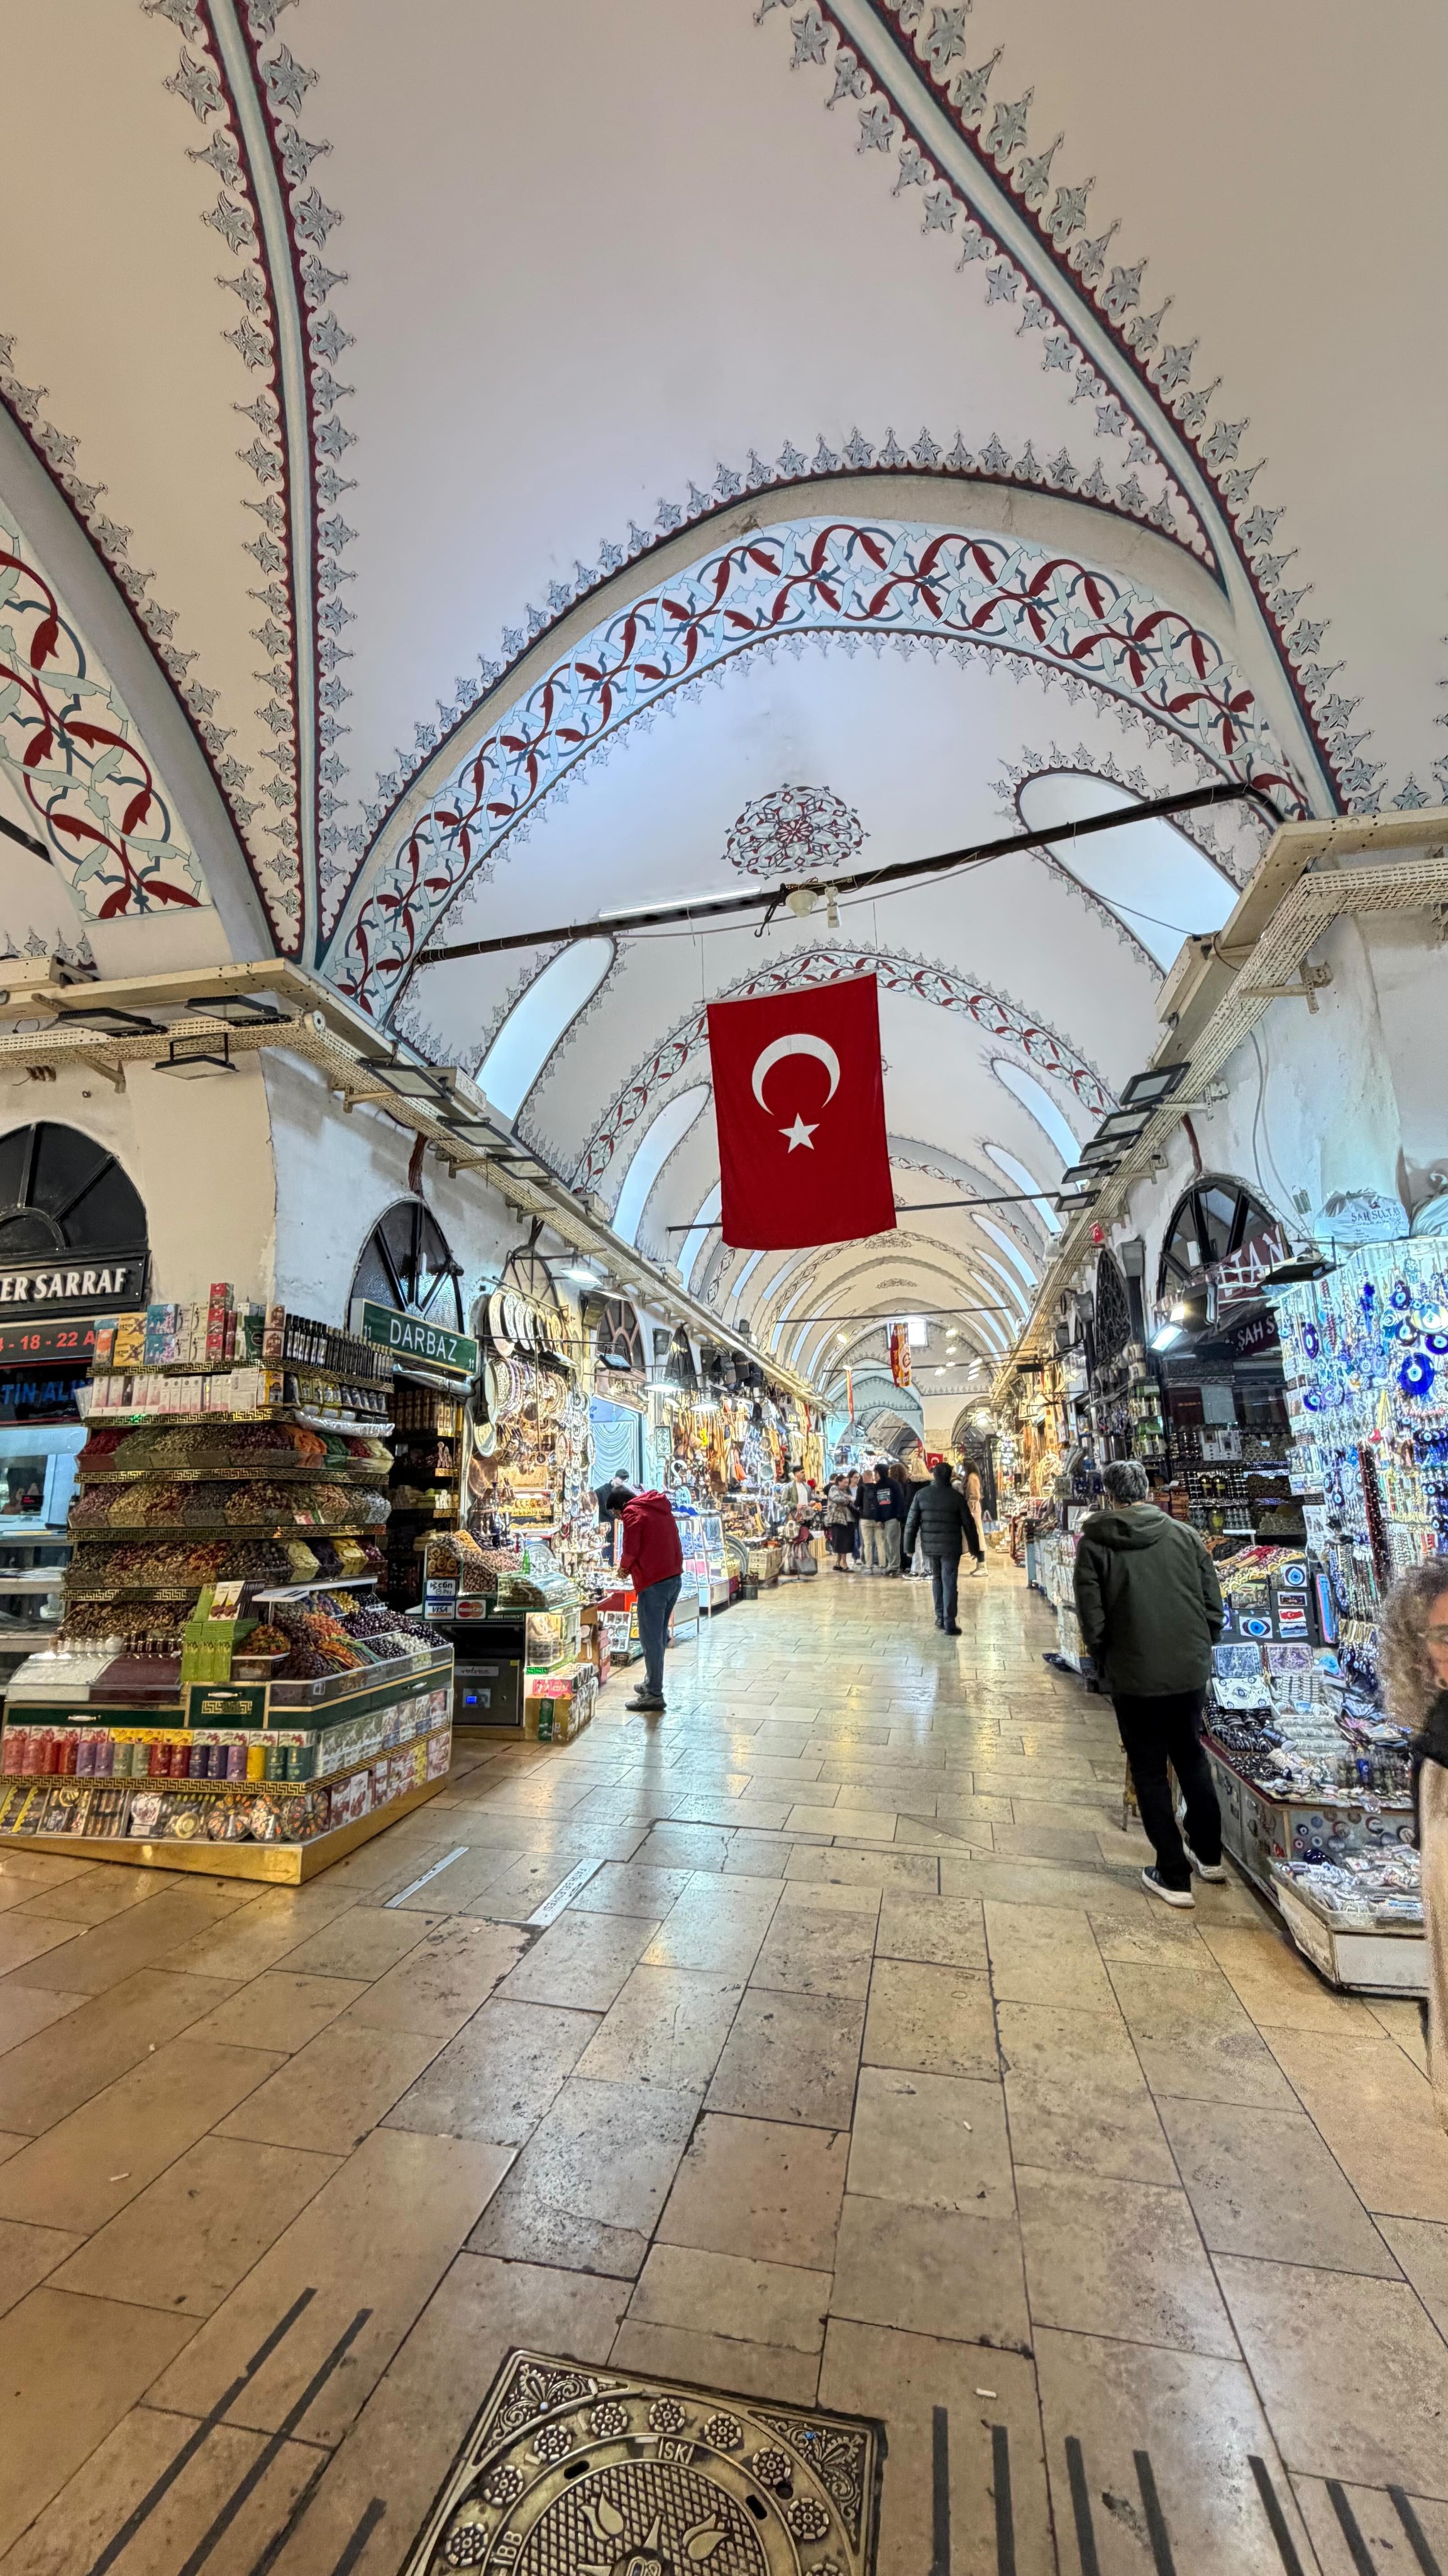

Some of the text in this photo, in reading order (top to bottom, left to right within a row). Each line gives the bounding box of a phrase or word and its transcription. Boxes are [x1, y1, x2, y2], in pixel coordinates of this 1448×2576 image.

[34, 1268, 126, 1299] SARRAF
[20, 1334, 41, 1350] 18
[56, 1331, 79, 1348] 22
[363, 1318, 475, 1370] 11 DARBAZ 11
